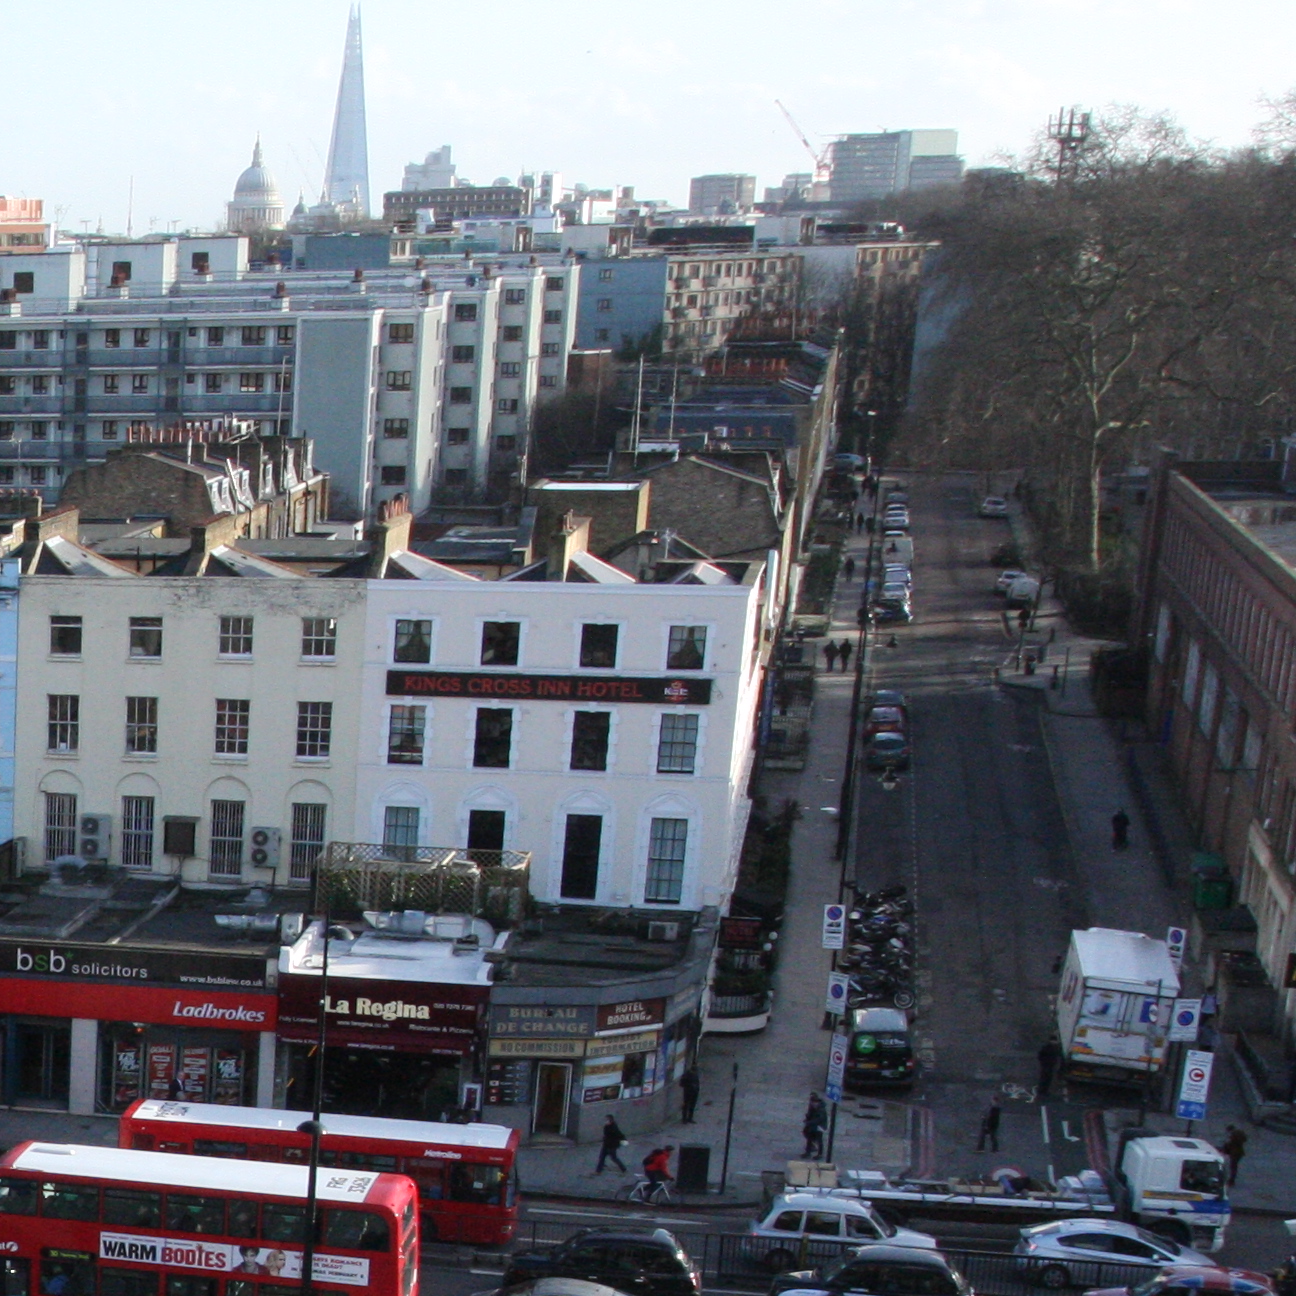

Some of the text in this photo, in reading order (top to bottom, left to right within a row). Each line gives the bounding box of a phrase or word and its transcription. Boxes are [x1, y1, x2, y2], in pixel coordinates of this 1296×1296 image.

[404, 676, 644, 698] KINGS CROSS INN HOTEL
[71, 963, 148, 978] solicitors
[173, 1001, 265, 1022] Ladbrokes
[324, 995, 430, 1020] La Regina
[615, 1001, 644, 1012] HOTEL
[496, 1022, 589, 1034] DE CHANGE
[103, 1240, 157, 1262] WARM
[161, 1243, 227, 1269] BODIES
